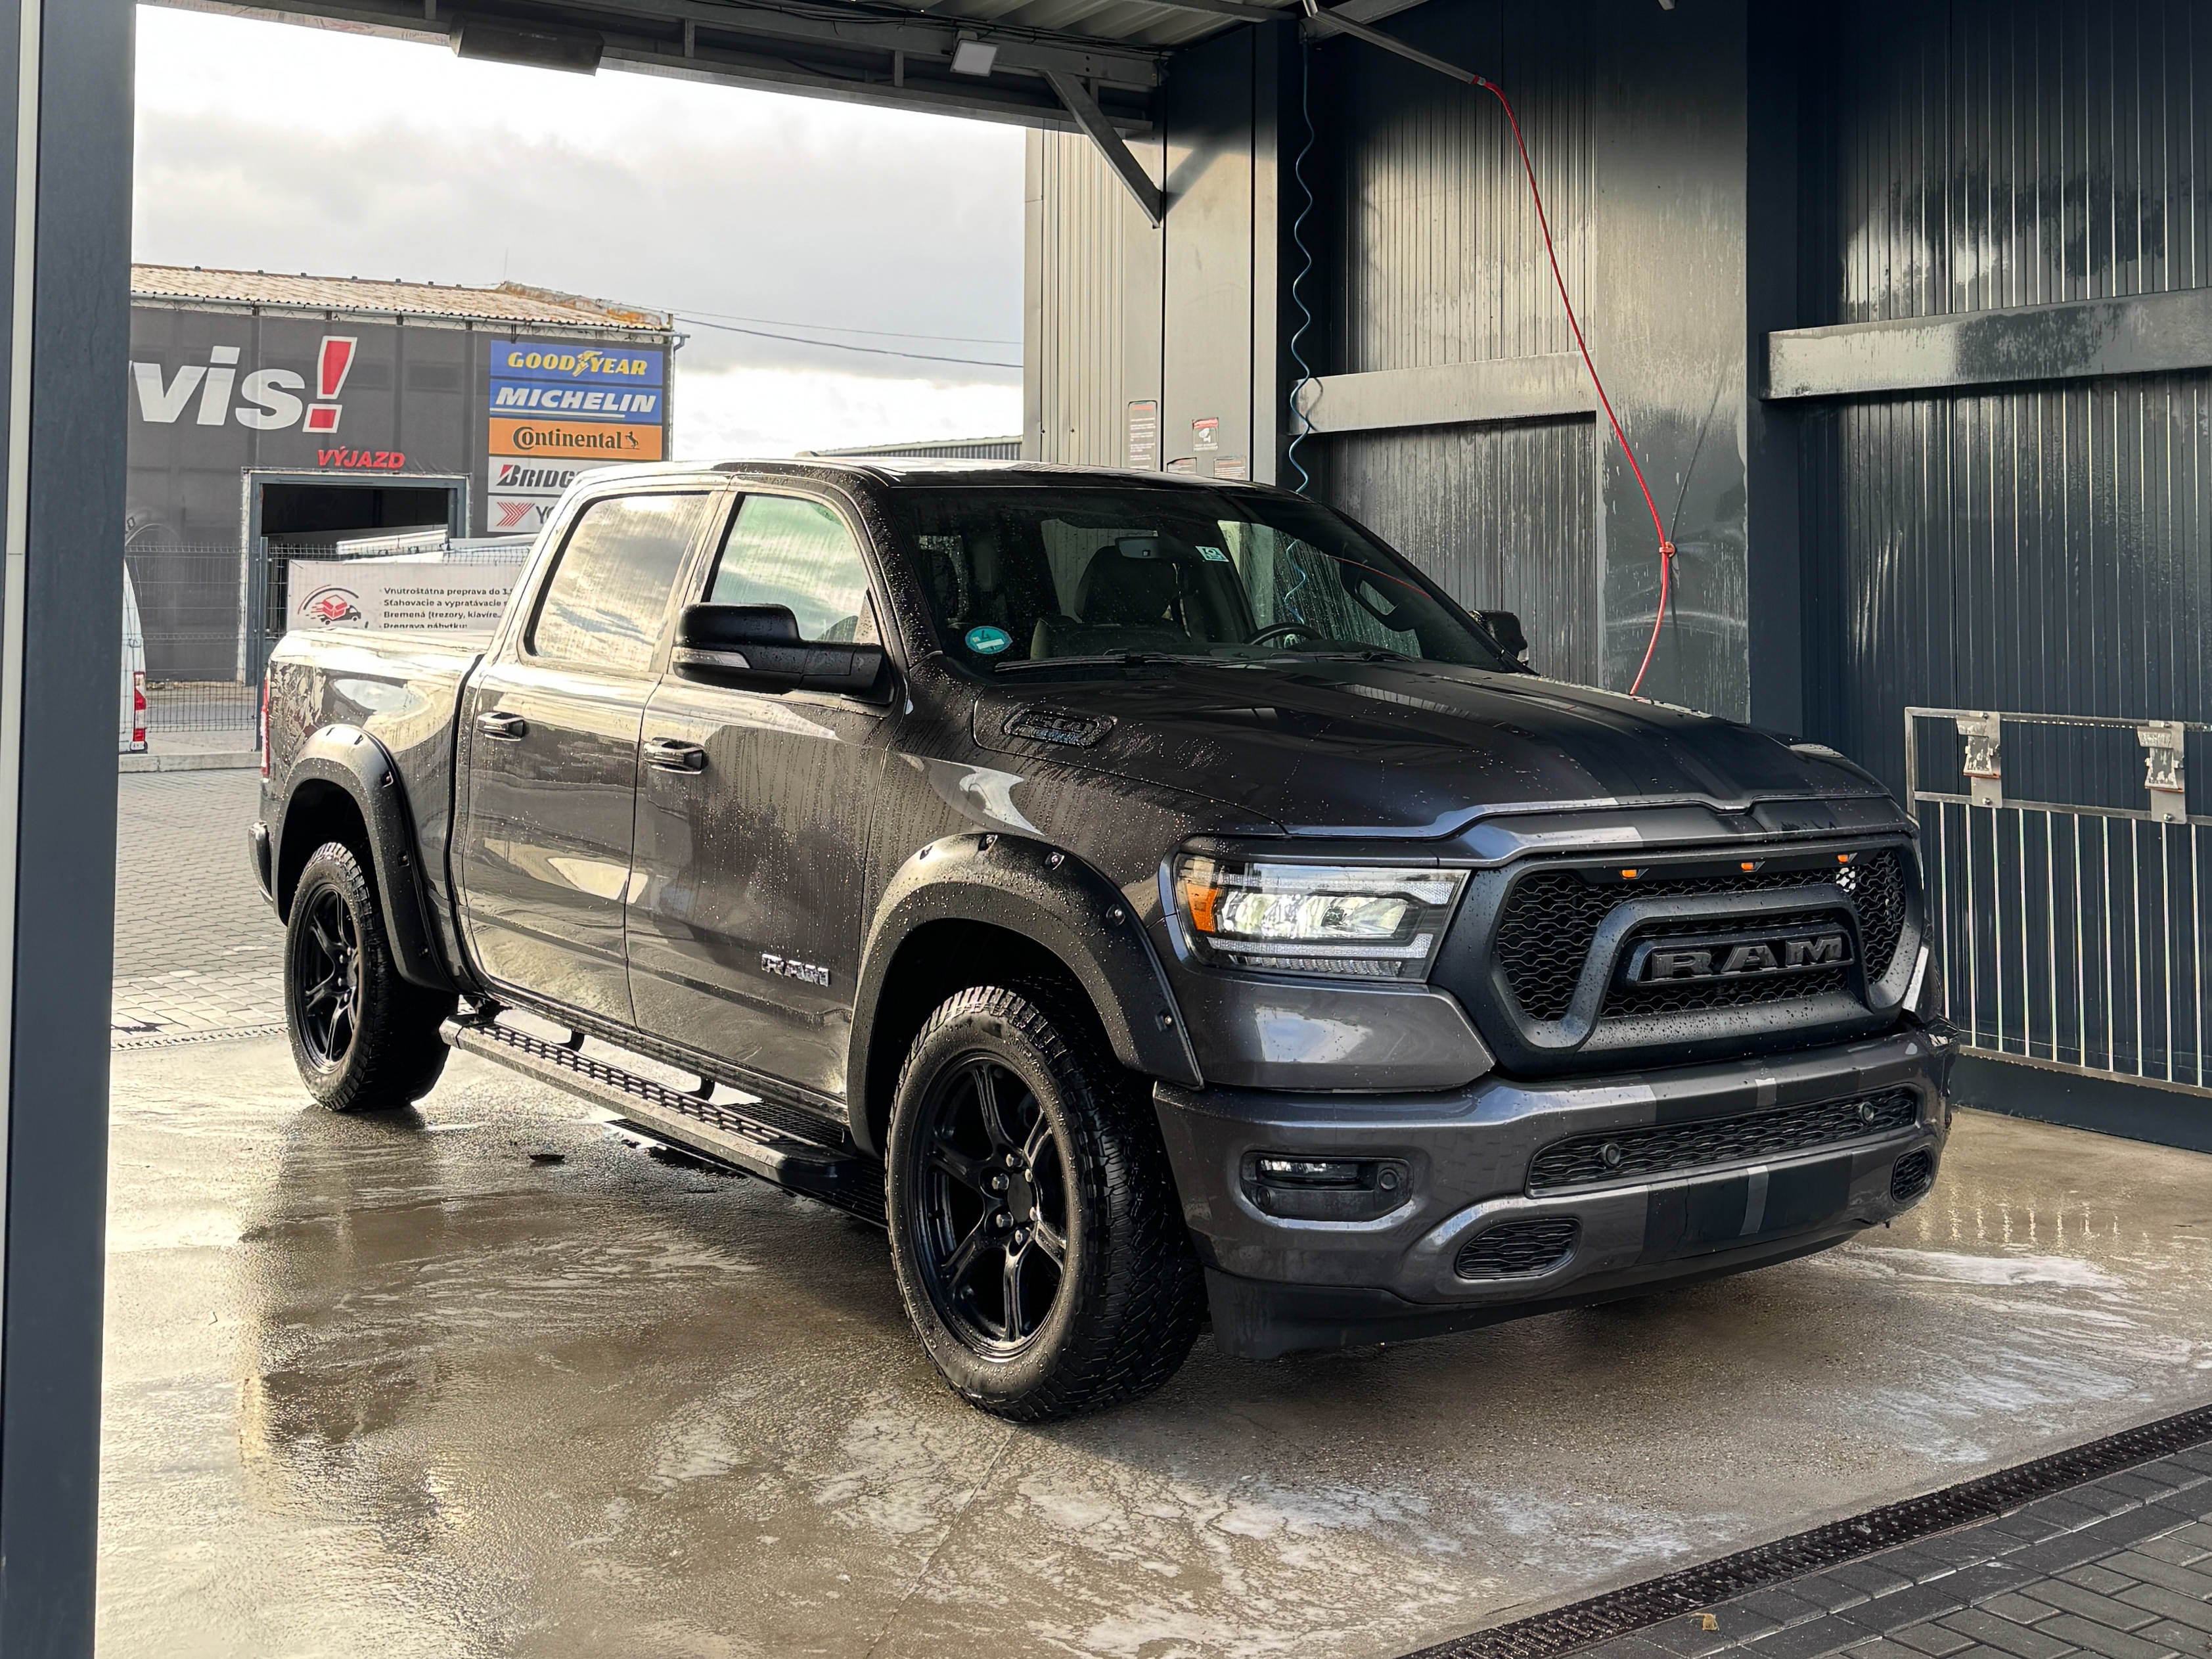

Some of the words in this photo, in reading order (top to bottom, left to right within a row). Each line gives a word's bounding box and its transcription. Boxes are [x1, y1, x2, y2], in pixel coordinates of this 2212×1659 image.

[129, 335, 358, 434] vis!
[495, 387, 656, 413] MICHELIN
[512, 426, 623, 451] Continental
[318, 445, 405, 468] VÝJAZD
[496, 465, 579, 488] BRIDG
[428, 611, 466, 620] (trezory,
[761, 953, 829, 987] RAM
[1652, 936, 1842, 981] RAM
